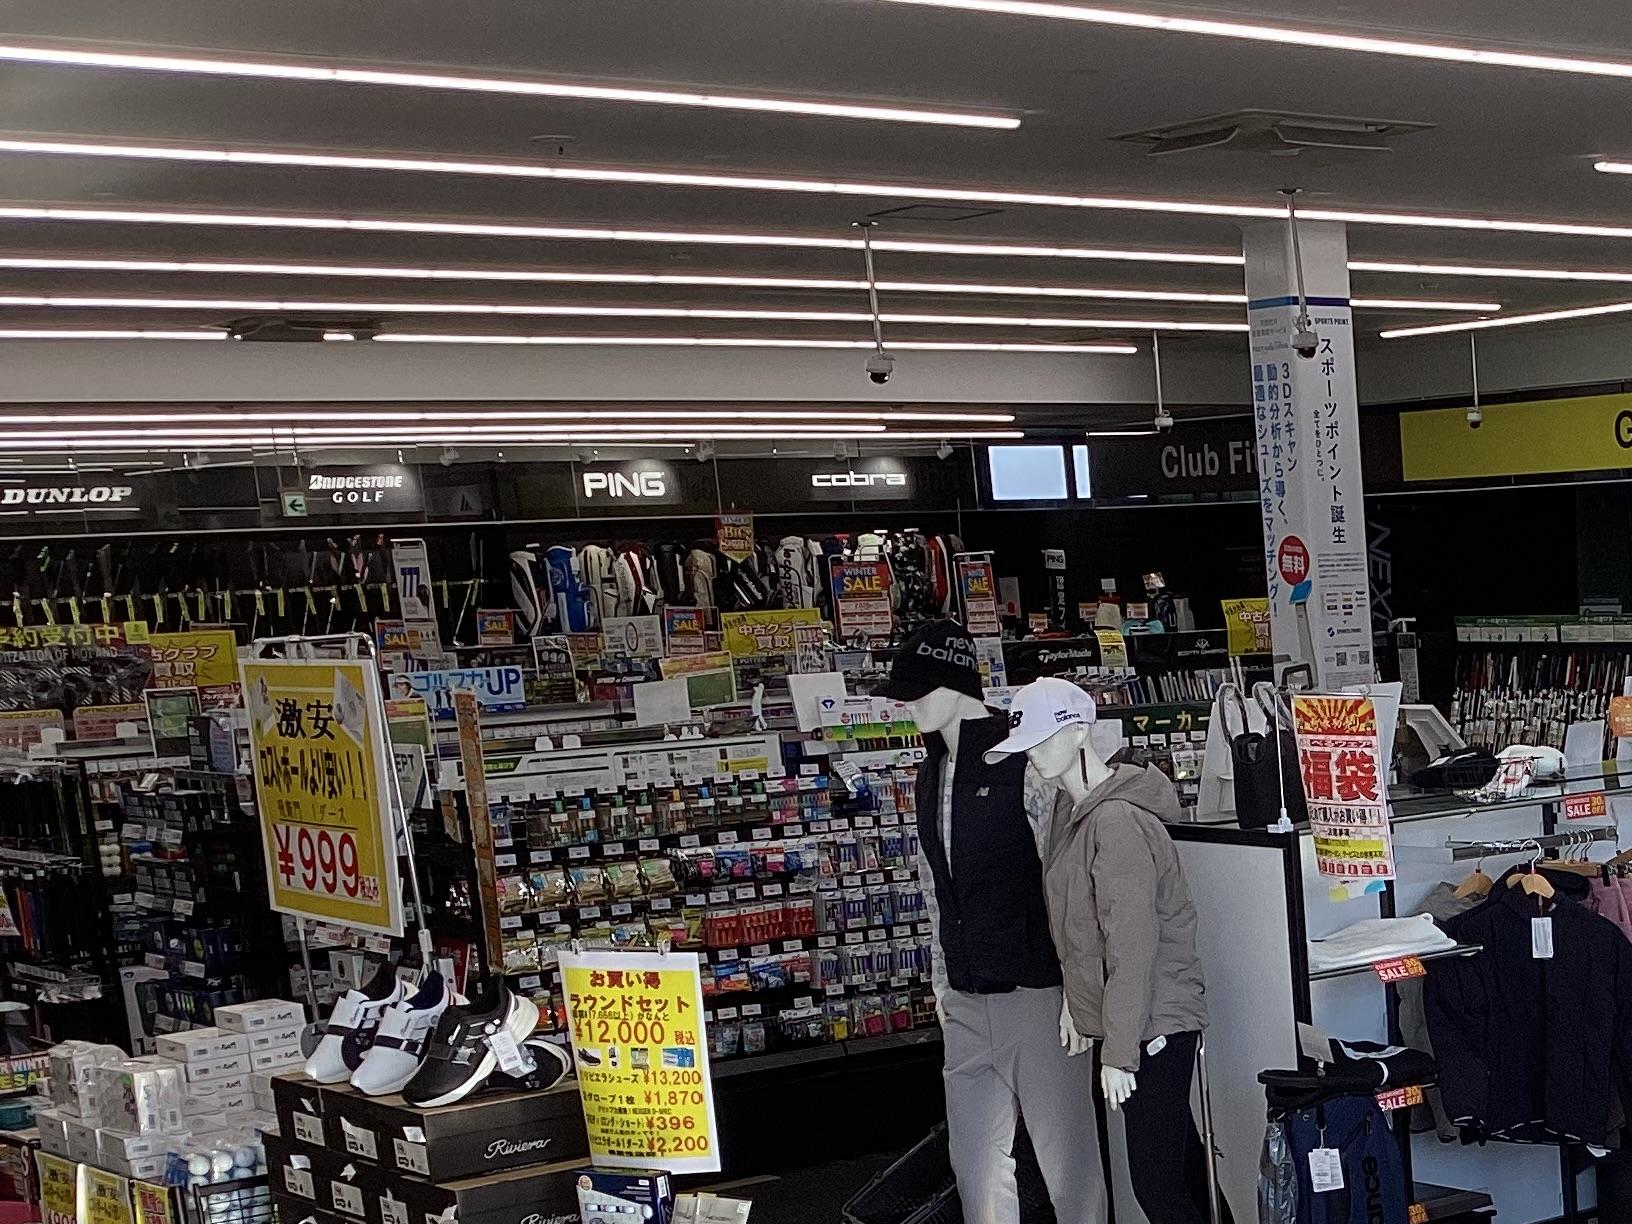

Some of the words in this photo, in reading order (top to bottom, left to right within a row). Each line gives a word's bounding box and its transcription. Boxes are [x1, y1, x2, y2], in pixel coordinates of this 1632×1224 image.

[1319, 338, 1347, 545] スポーツポイント誕生
[1161, 445, 1219, 479] Club
[308, 474, 402, 491] BRIDGESTONE
[583, 471, 665, 498] PING
[811, 471, 906, 487] cobra
[2, 486, 133, 504] DUNLOP
[332, 491, 385, 503] GOLF
[843, 567, 877, 577] WINTER
[843, 577, 881, 592] SALE
[968, 577, 988, 592] SALE
[484, 620, 511, 632] SALE
[673, 619, 700, 632] SALE
[945, 636, 977, 652] new
[1038, 649, 1092, 664] TaylorMade
[275, 697, 336, 741] 激安
[1133, 710, 1210, 731] マーカー
[1302, 750, 1380, 801] 福袋
[1566, 804, 1592, 818] SALE
[272, 823, 359, 898] ¥999
[590, 971, 661, 989] お買い得
[1379, 967, 1409, 981] SALE
[570, 993, 690, 1014] ラウンドセット
[574, 1020, 665, 1046] ¥12,000
[675, 1031, 696, 1046] 税込
[643, 1070, 702, 1085] ¥13,200
[644, 1090, 703, 1106] ¥1,870
[1378, 1096, 1406, 1111] SALE
[647, 1116, 695, 1131] ¥396
[484, 1138, 552, 1160] Riviera
[647, 1136, 708, 1153] ¥2,200
